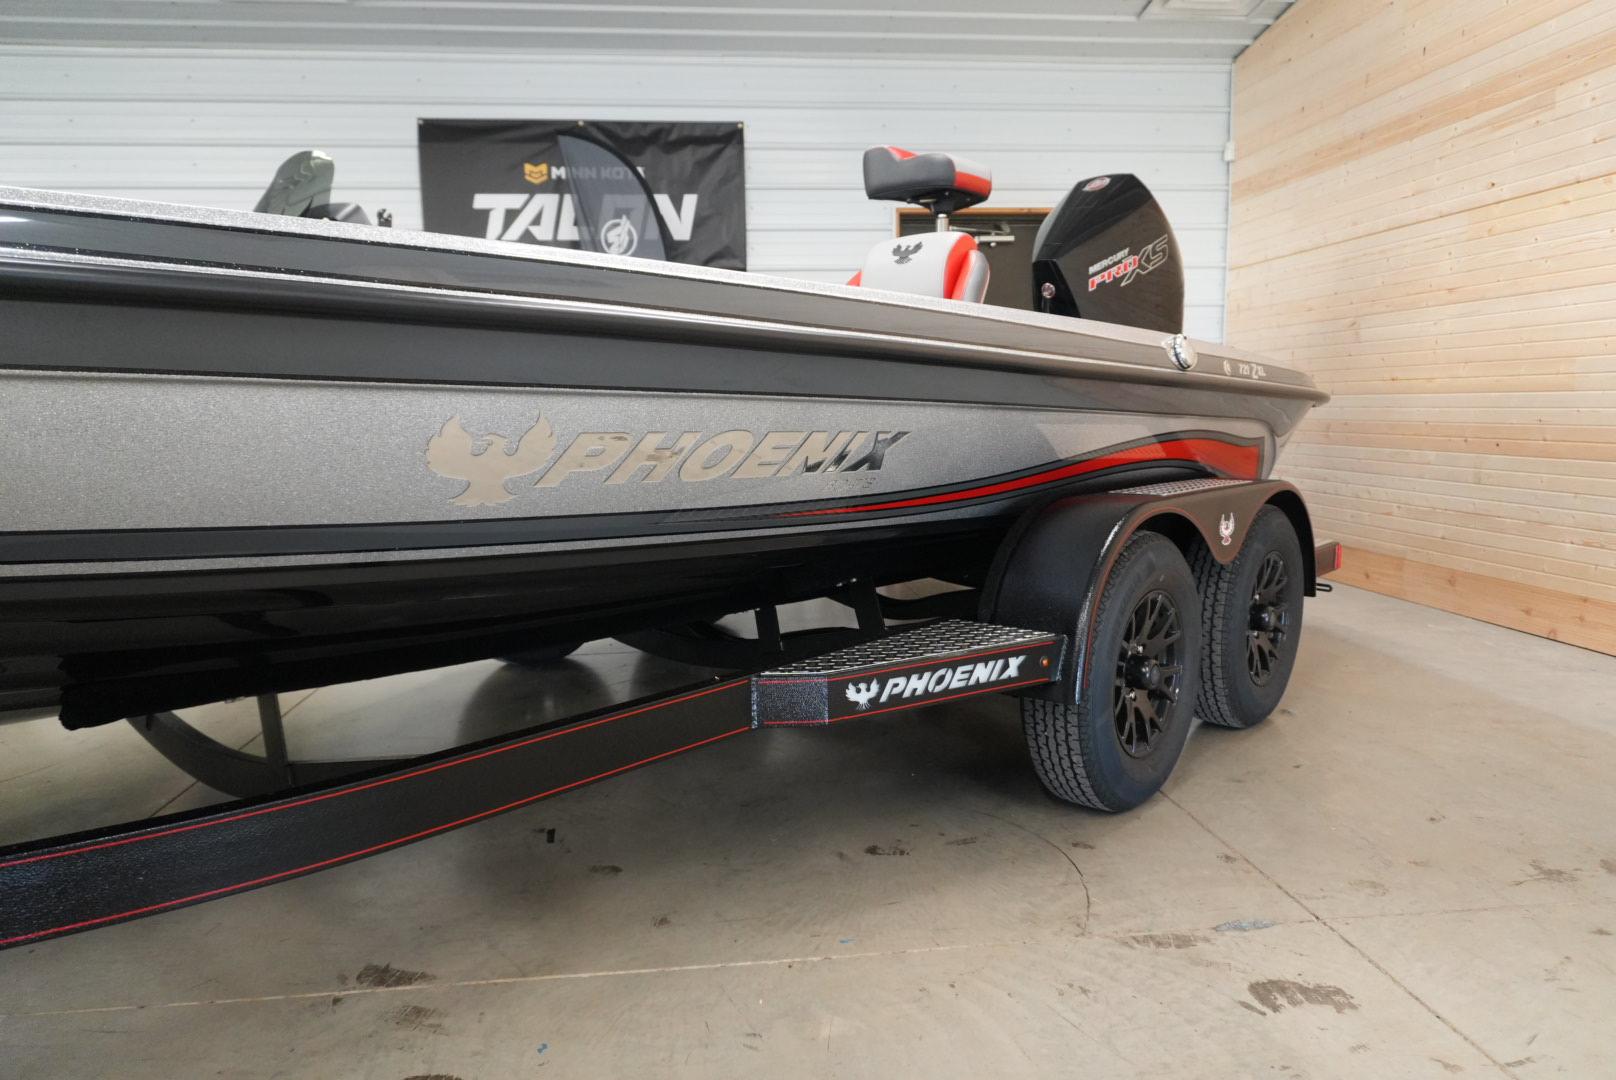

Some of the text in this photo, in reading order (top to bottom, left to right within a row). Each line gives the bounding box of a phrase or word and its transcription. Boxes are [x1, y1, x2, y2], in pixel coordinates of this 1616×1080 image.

[1088, 247, 1129, 275] MERCURY
[533, 430, 912, 488] PHOENIX
[879, 655, 1027, 703] PHOENIX
